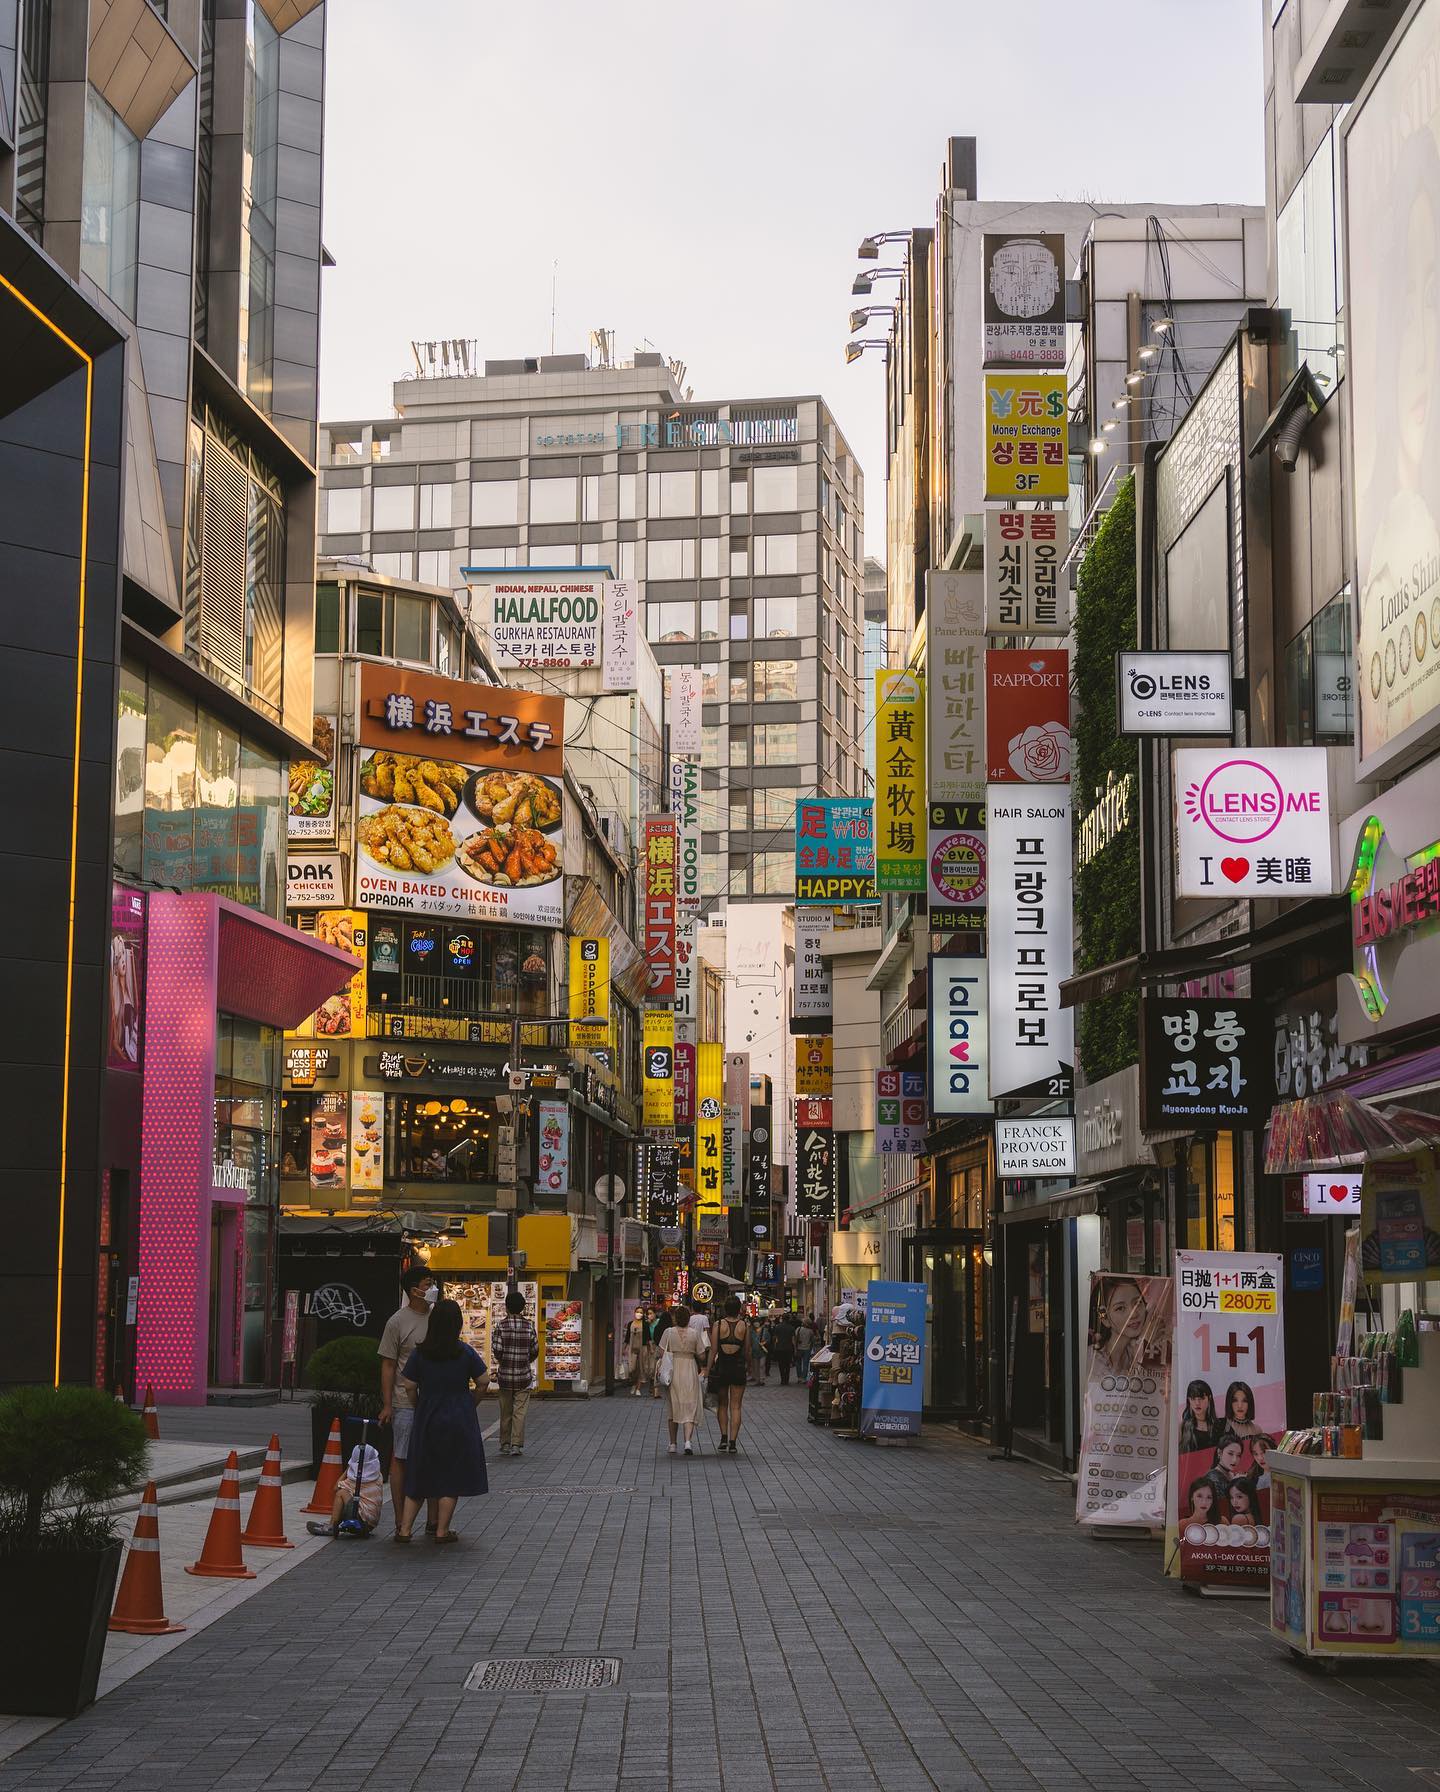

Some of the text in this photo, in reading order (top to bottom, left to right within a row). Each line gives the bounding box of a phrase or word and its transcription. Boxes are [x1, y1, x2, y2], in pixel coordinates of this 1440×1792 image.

[992, 424, 1061, 436] Money Exchange
[991, 441, 1064, 465] 상품권
[1015, 474, 1039, 490] 3F
[999, 513, 1057, 541] 명품
[495, 585, 594, 594] INDIAN, NEPALI, CHINESE
[998, 544, 1023, 625] 시계수리
[1034, 544, 1057, 624] 오리엔트
[1380, 578, 1411, 633] Louis
[495, 626, 597, 640] GURKHA RESTAURANT
[497, 643, 597, 657] 구르카 레스토랑
[519, 658, 570, 667] 775-8860
[993, 674, 1063, 687] RAPPORT
[1200, 692, 1225, 700] STORE
[384, 694, 553, 752] 横浜エステ
[990, 769, 1005, 777] 4F
[683, 763, 698, 829] HALAL
[1286, 792, 1321, 812] ME
[994, 808, 1065, 818] HAIR SALON
[799, 806, 827, 838] 足
[948, 851, 975, 860] eve
[683, 838, 698, 896] FOOD
[1256, 857, 1312, 885] 美瞳
[360, 877, 509, 904] OVEN BAKED CHICKEN
[797, 878, 865, 898] HAPPY
[360, 892, 414, 908] OPPADAK
[648, 837, 677, 989] 横浜エステ
[1014, 838, 1049, 1047] 프랑크 프로보
[588, 963, 596, 1014] OPPADA
[1161, 1009, 1247, 1052] 명동
[291, 1049, 329, 1058] KOREAN
[287, 1059, 328, 1069] DESSERT
[292, 1069, 316, 1078] CAFE
[1161, 1056, 1248, 1099] 교자
[880, 1074, 922, 1093] $ 元
[1048, 1079, 1070, 1095] 2F
[880, 1104, 922, 1120] ¥ €
[1162, 1104, 1248, 1115] Myeongdong KyoJa
[1003, 1126, 1062, 1139] FRANCK
[1001, 1141, 1067, 1154] PROVOST
[700, 1133, 719, 1190] 김밥
[1003, 1157, 1066, 1168] HAIR SALON
[811, 1205, 822, 1213] 2F
[1294, 1253, 1320, 1263] CESCO
[1182, 1291, 1272, 1310] 60片 280元
[866, 1335, 920, 1364] 6천원
[1193, 1323, 1265, 1374] 1+1
[879, 1365, 912, 1385] 할인
[1191, 1552, 1235, 1561] AKMA 1-DAY
